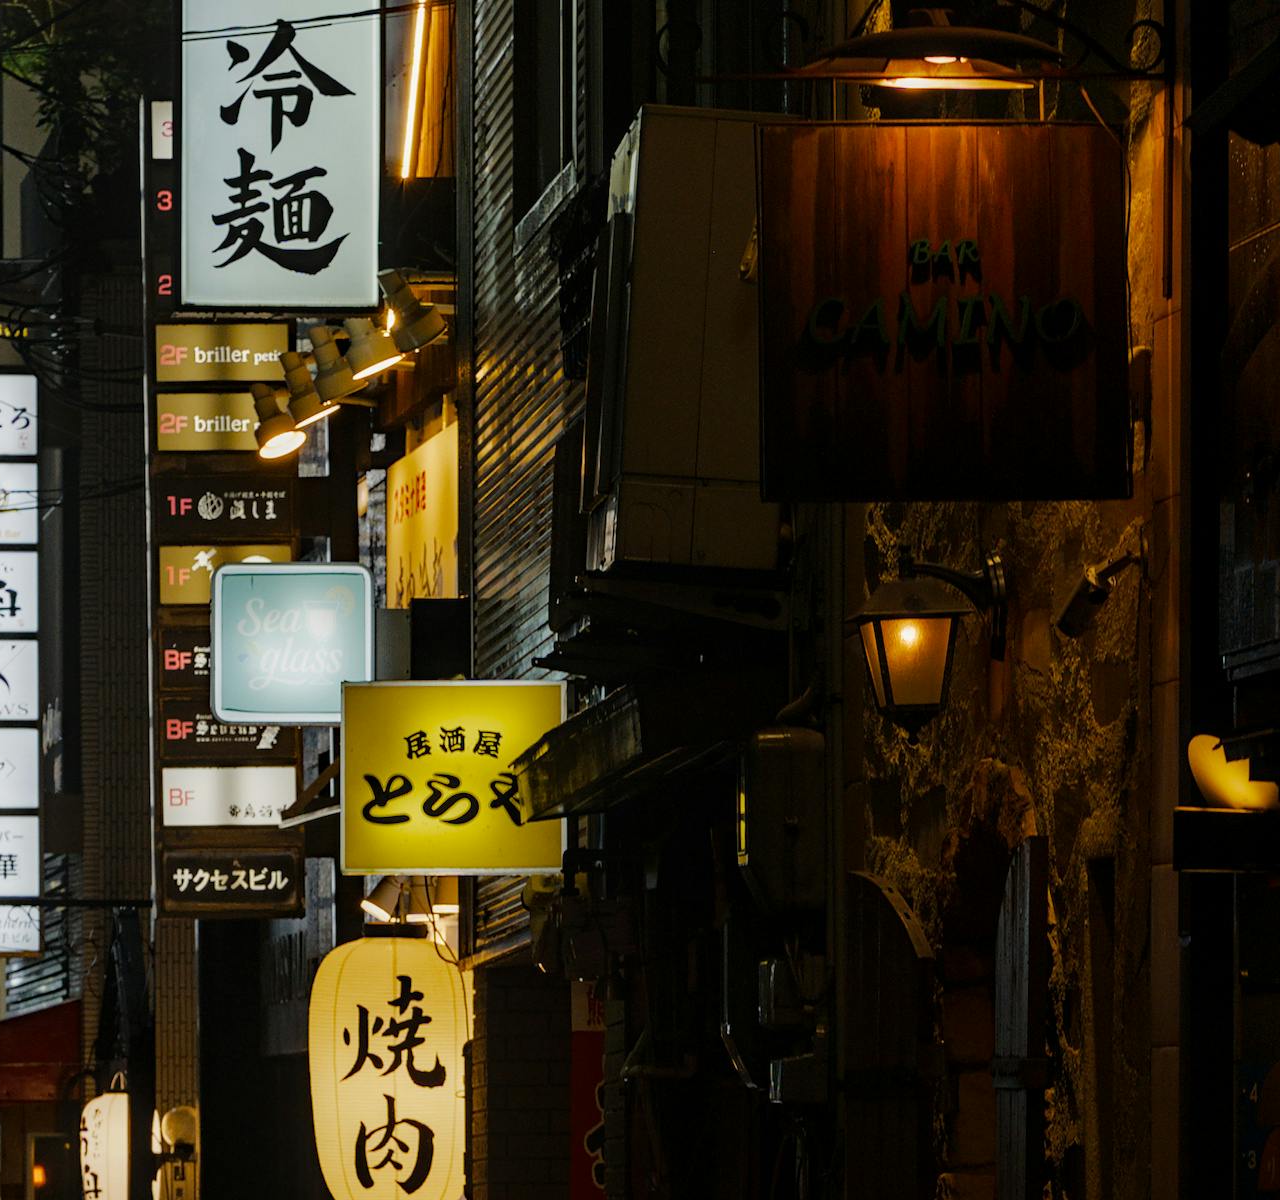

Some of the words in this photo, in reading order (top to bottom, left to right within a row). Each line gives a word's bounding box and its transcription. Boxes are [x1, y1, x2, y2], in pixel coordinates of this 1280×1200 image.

[211, 18, 356, 275] 冷麺
[160, 344, 188, 365] 2F
[194, 346, 250, 363] briller
[160, 413, 188, 433] 2F
[194, 415, 250, 433] briller
[167, 496, 193, 516] 1F
[166, 565, 191, 586] 1F
[237, 597, 303, 637] Sea
[164, 650, 192, 671] BF
[248, 640, 344, 691] glass
[166, 719, 193, 740] BF
[404, 726, 503, 761] 居酒屋
[169, 788, 196, 806] BF
[173, 867, 289, 892] サクセスビル
[340, 975, 447, 1195] 焼肉
